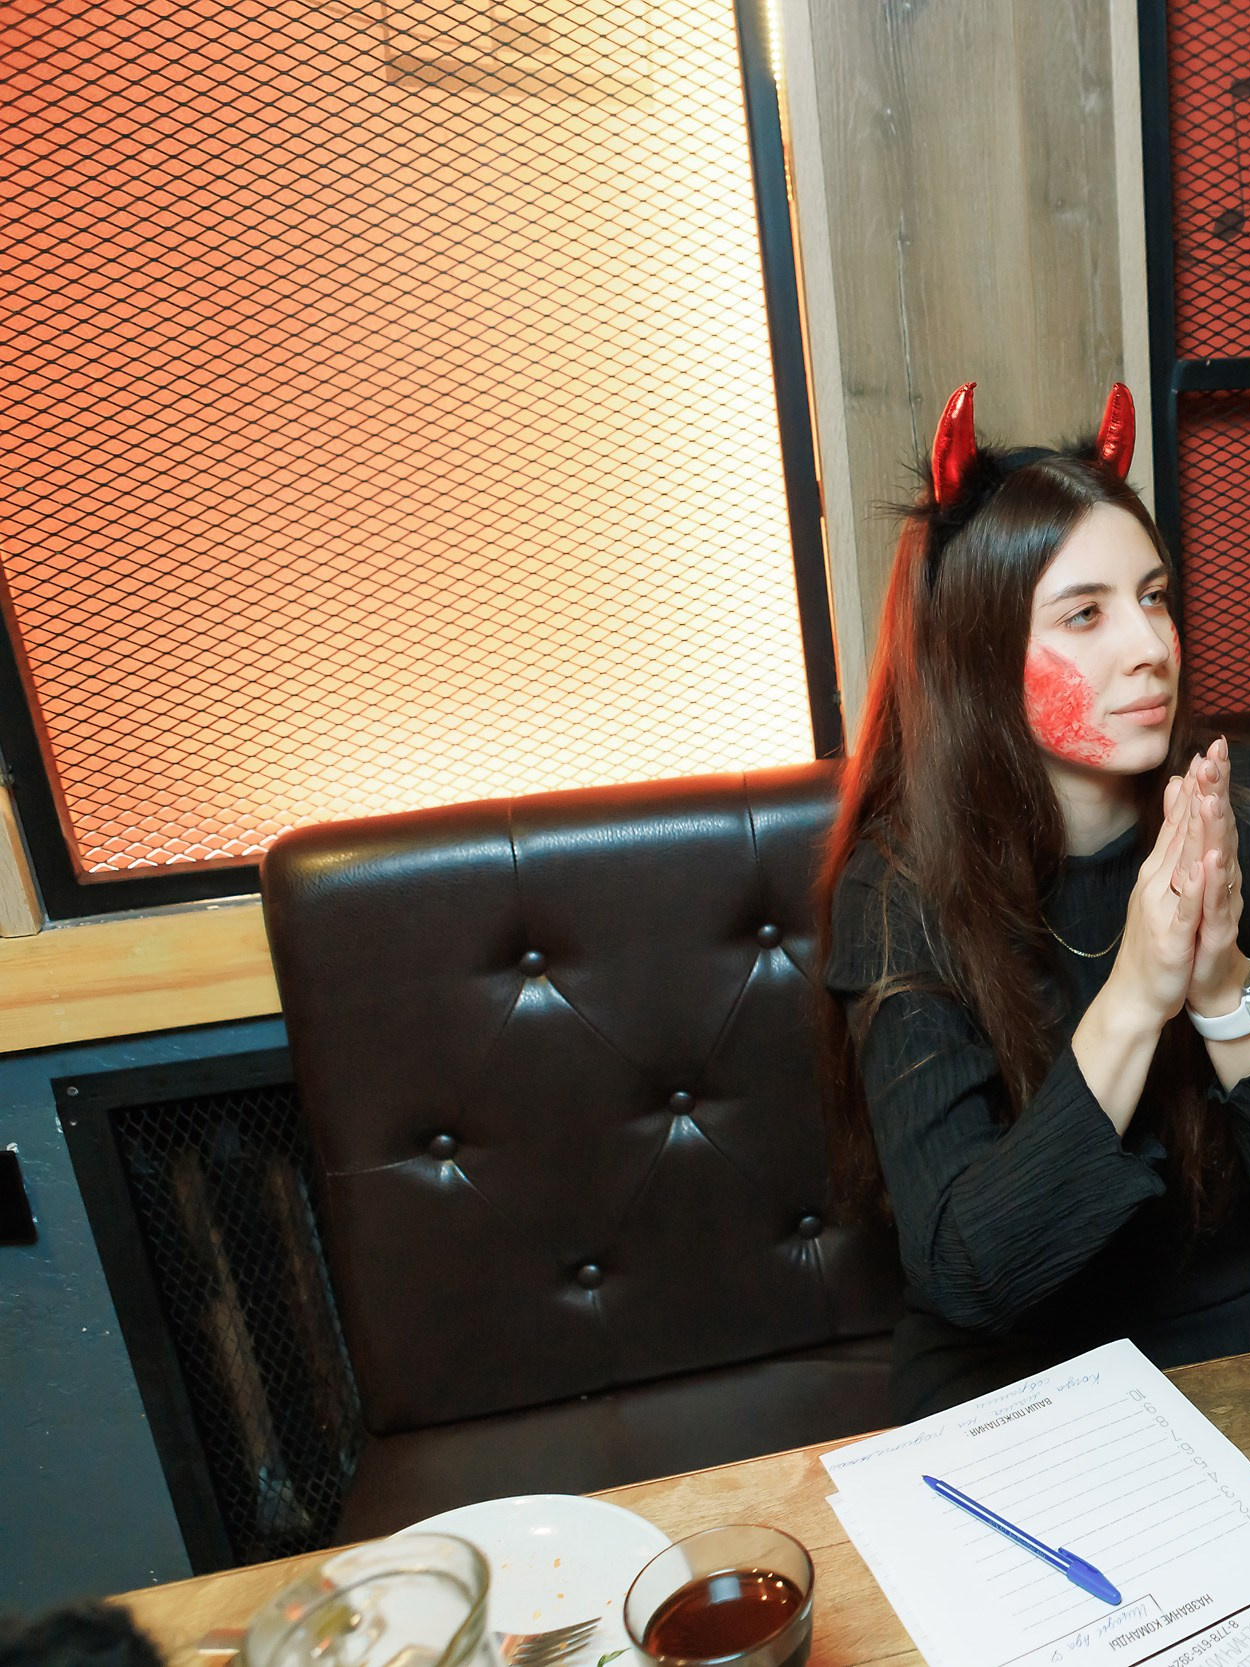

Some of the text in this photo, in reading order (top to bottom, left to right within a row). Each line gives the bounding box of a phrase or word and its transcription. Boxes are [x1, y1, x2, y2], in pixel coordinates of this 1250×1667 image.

[1025, 1397, 1053, 1414] ВАШИ
[1109, 1593, 1214, 1651] НАЗВАНИЕ КОМАНДЫ
